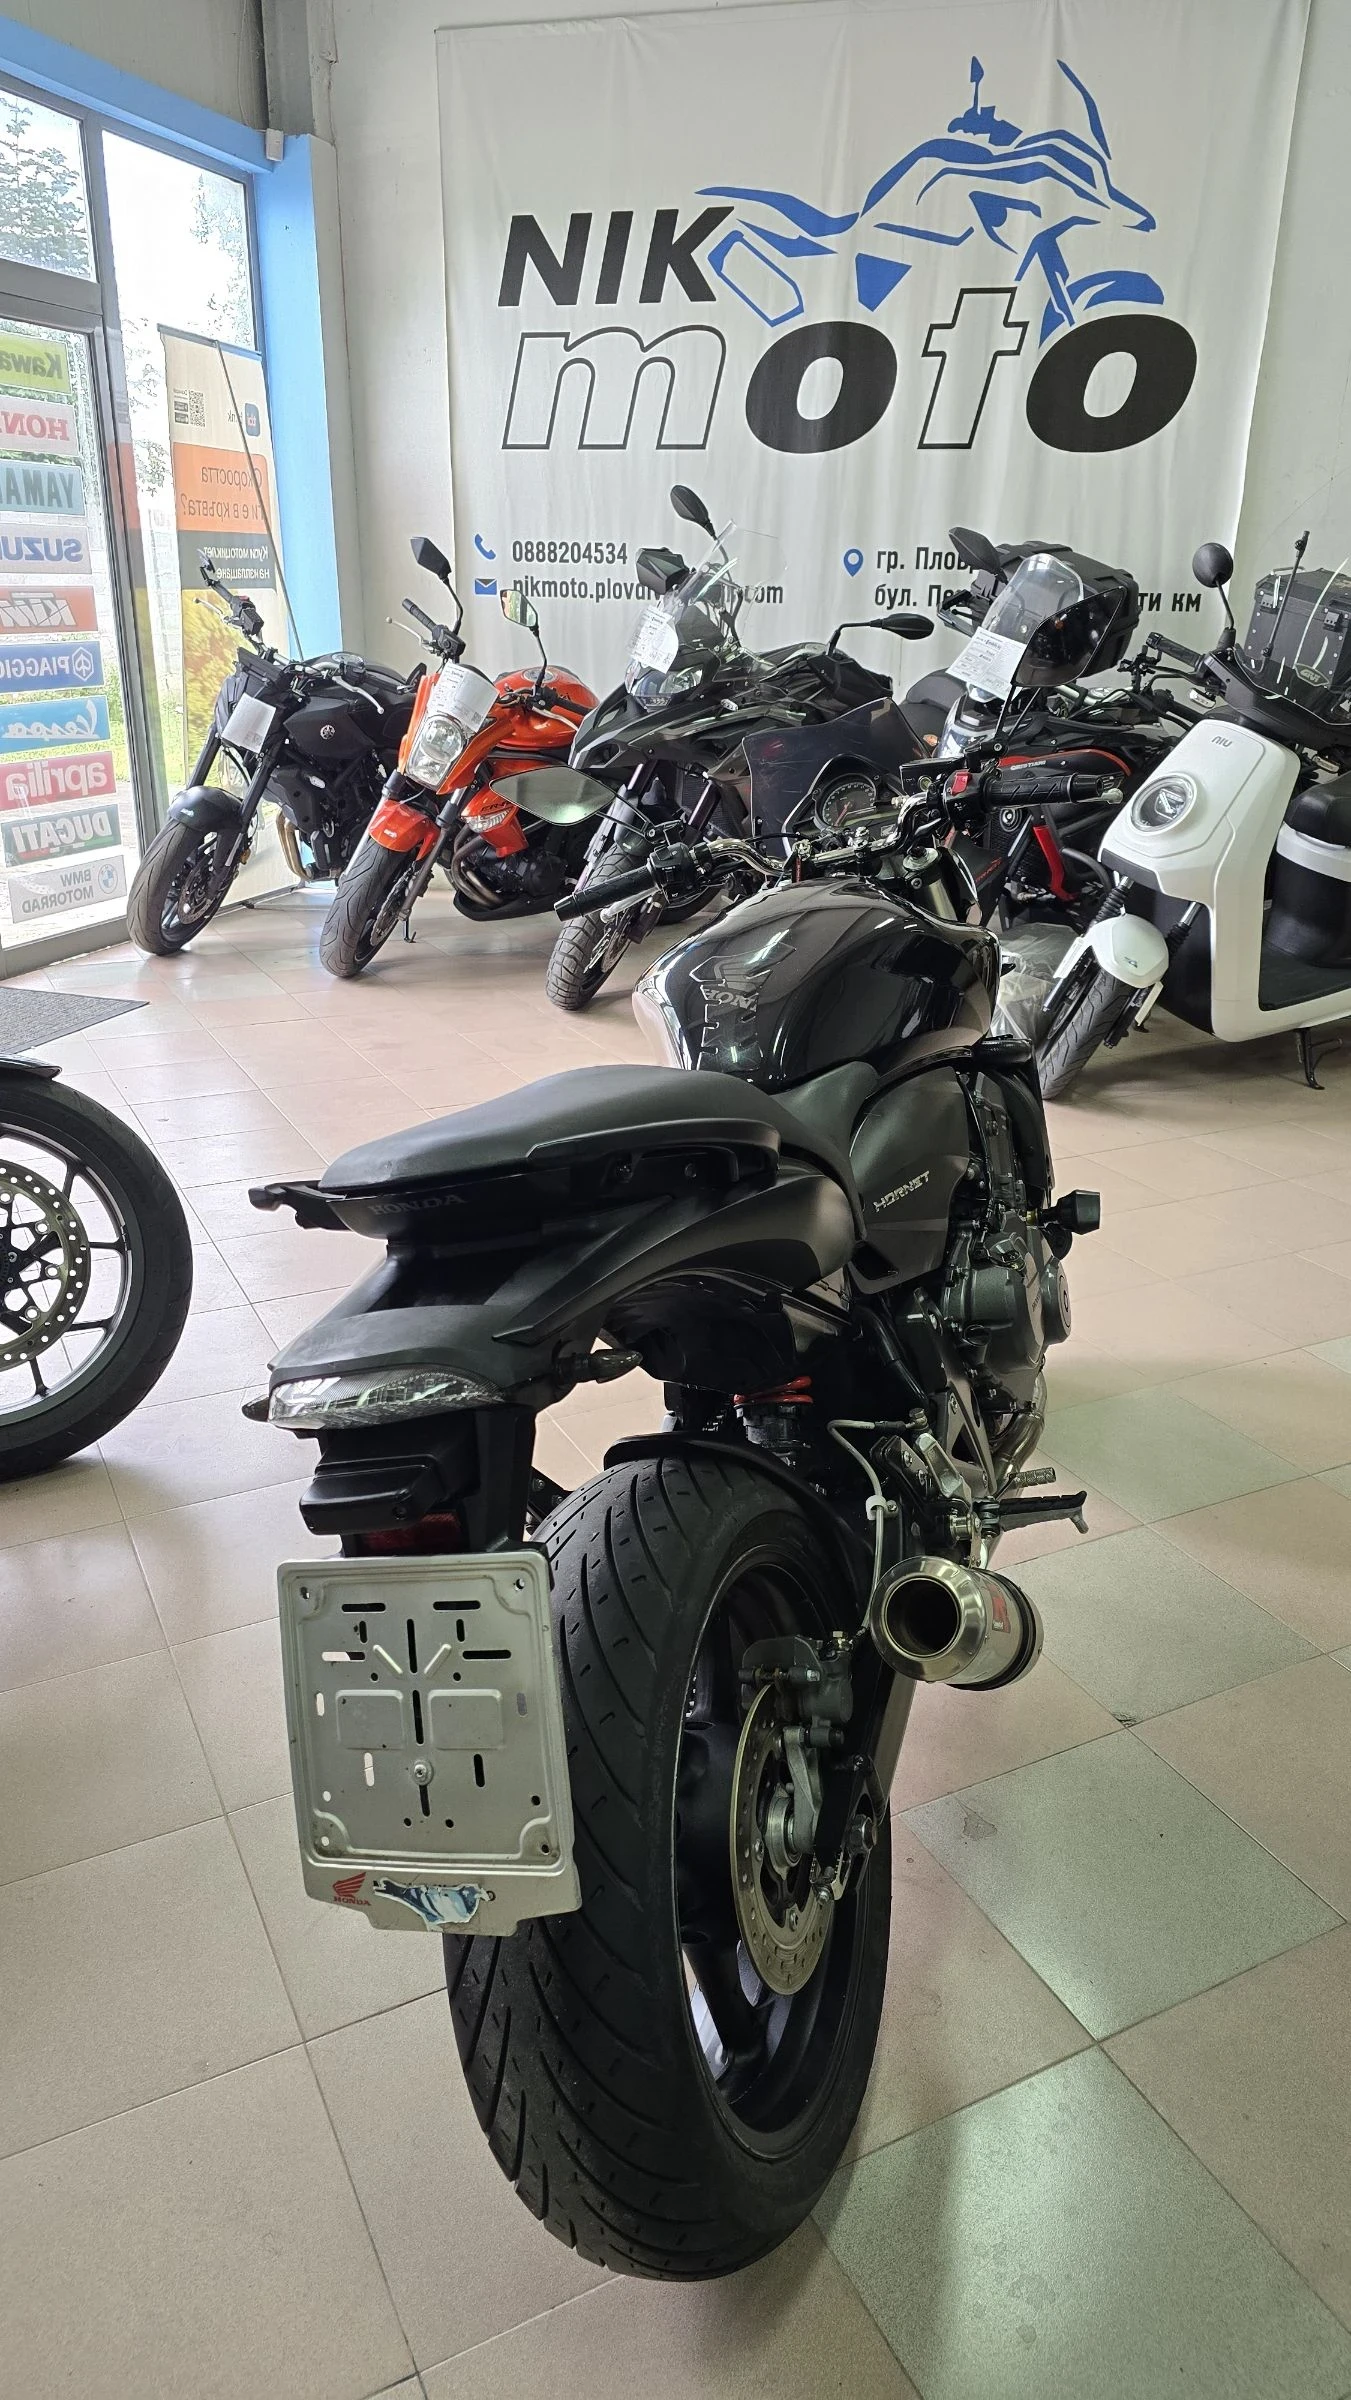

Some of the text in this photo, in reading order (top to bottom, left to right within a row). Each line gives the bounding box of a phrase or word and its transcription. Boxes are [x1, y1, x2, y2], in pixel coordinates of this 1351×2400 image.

[497, 205, 734, 306] NIK
[501, 287, 1198, 454] moto
[512, 540, 628, 565] 0888204534
[876, 546, 974, 574] гр. Плов
[874, 583, 918, 610] бул.
[1171, 592, 1203, 613] км
[367, 1194, 468, 1216] HONDA
[872, 1170, 930, 1213] HORNET
[333, 1895, 372, 1907] HONDA
